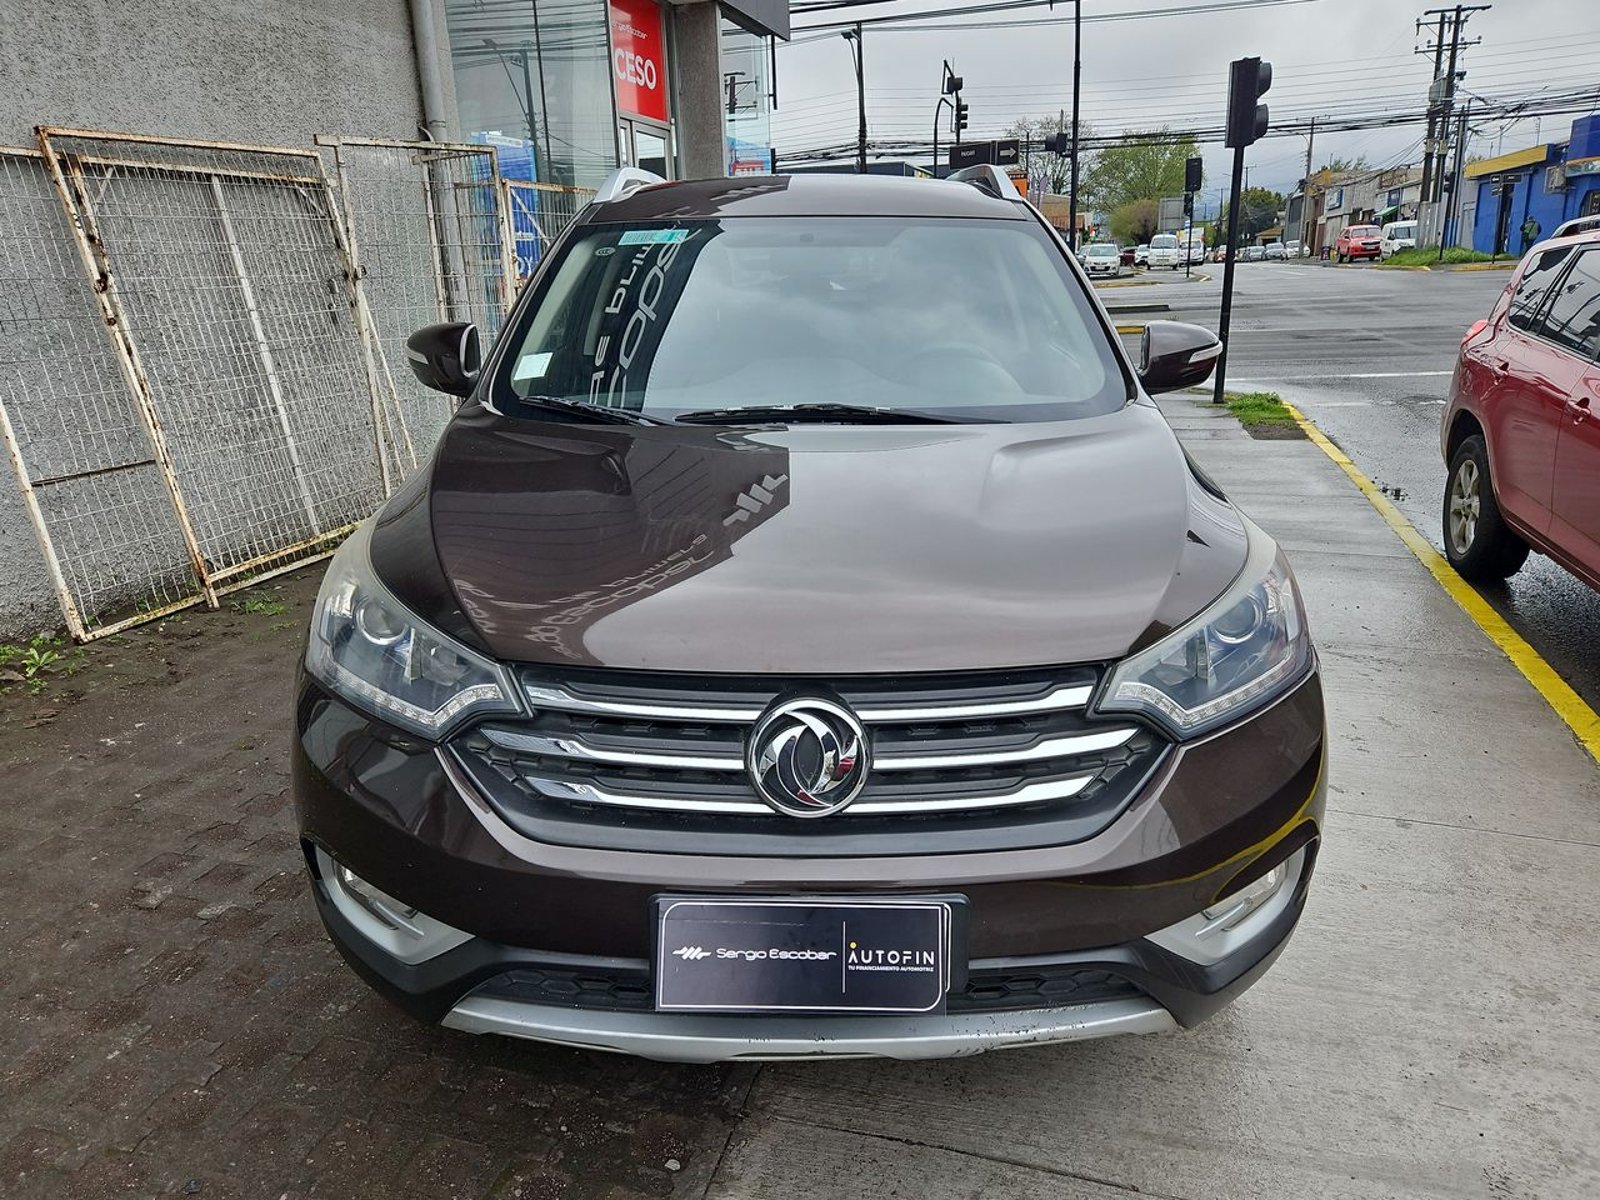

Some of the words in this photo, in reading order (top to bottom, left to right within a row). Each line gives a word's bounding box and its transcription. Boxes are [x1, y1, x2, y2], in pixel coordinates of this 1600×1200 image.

[614, 47, 656, 90] CESO
[716, 948, 767, 961] Sergo
[769, 949, 837, 961] Escobar
[848, 945, 935, 965] AUTOFIN
